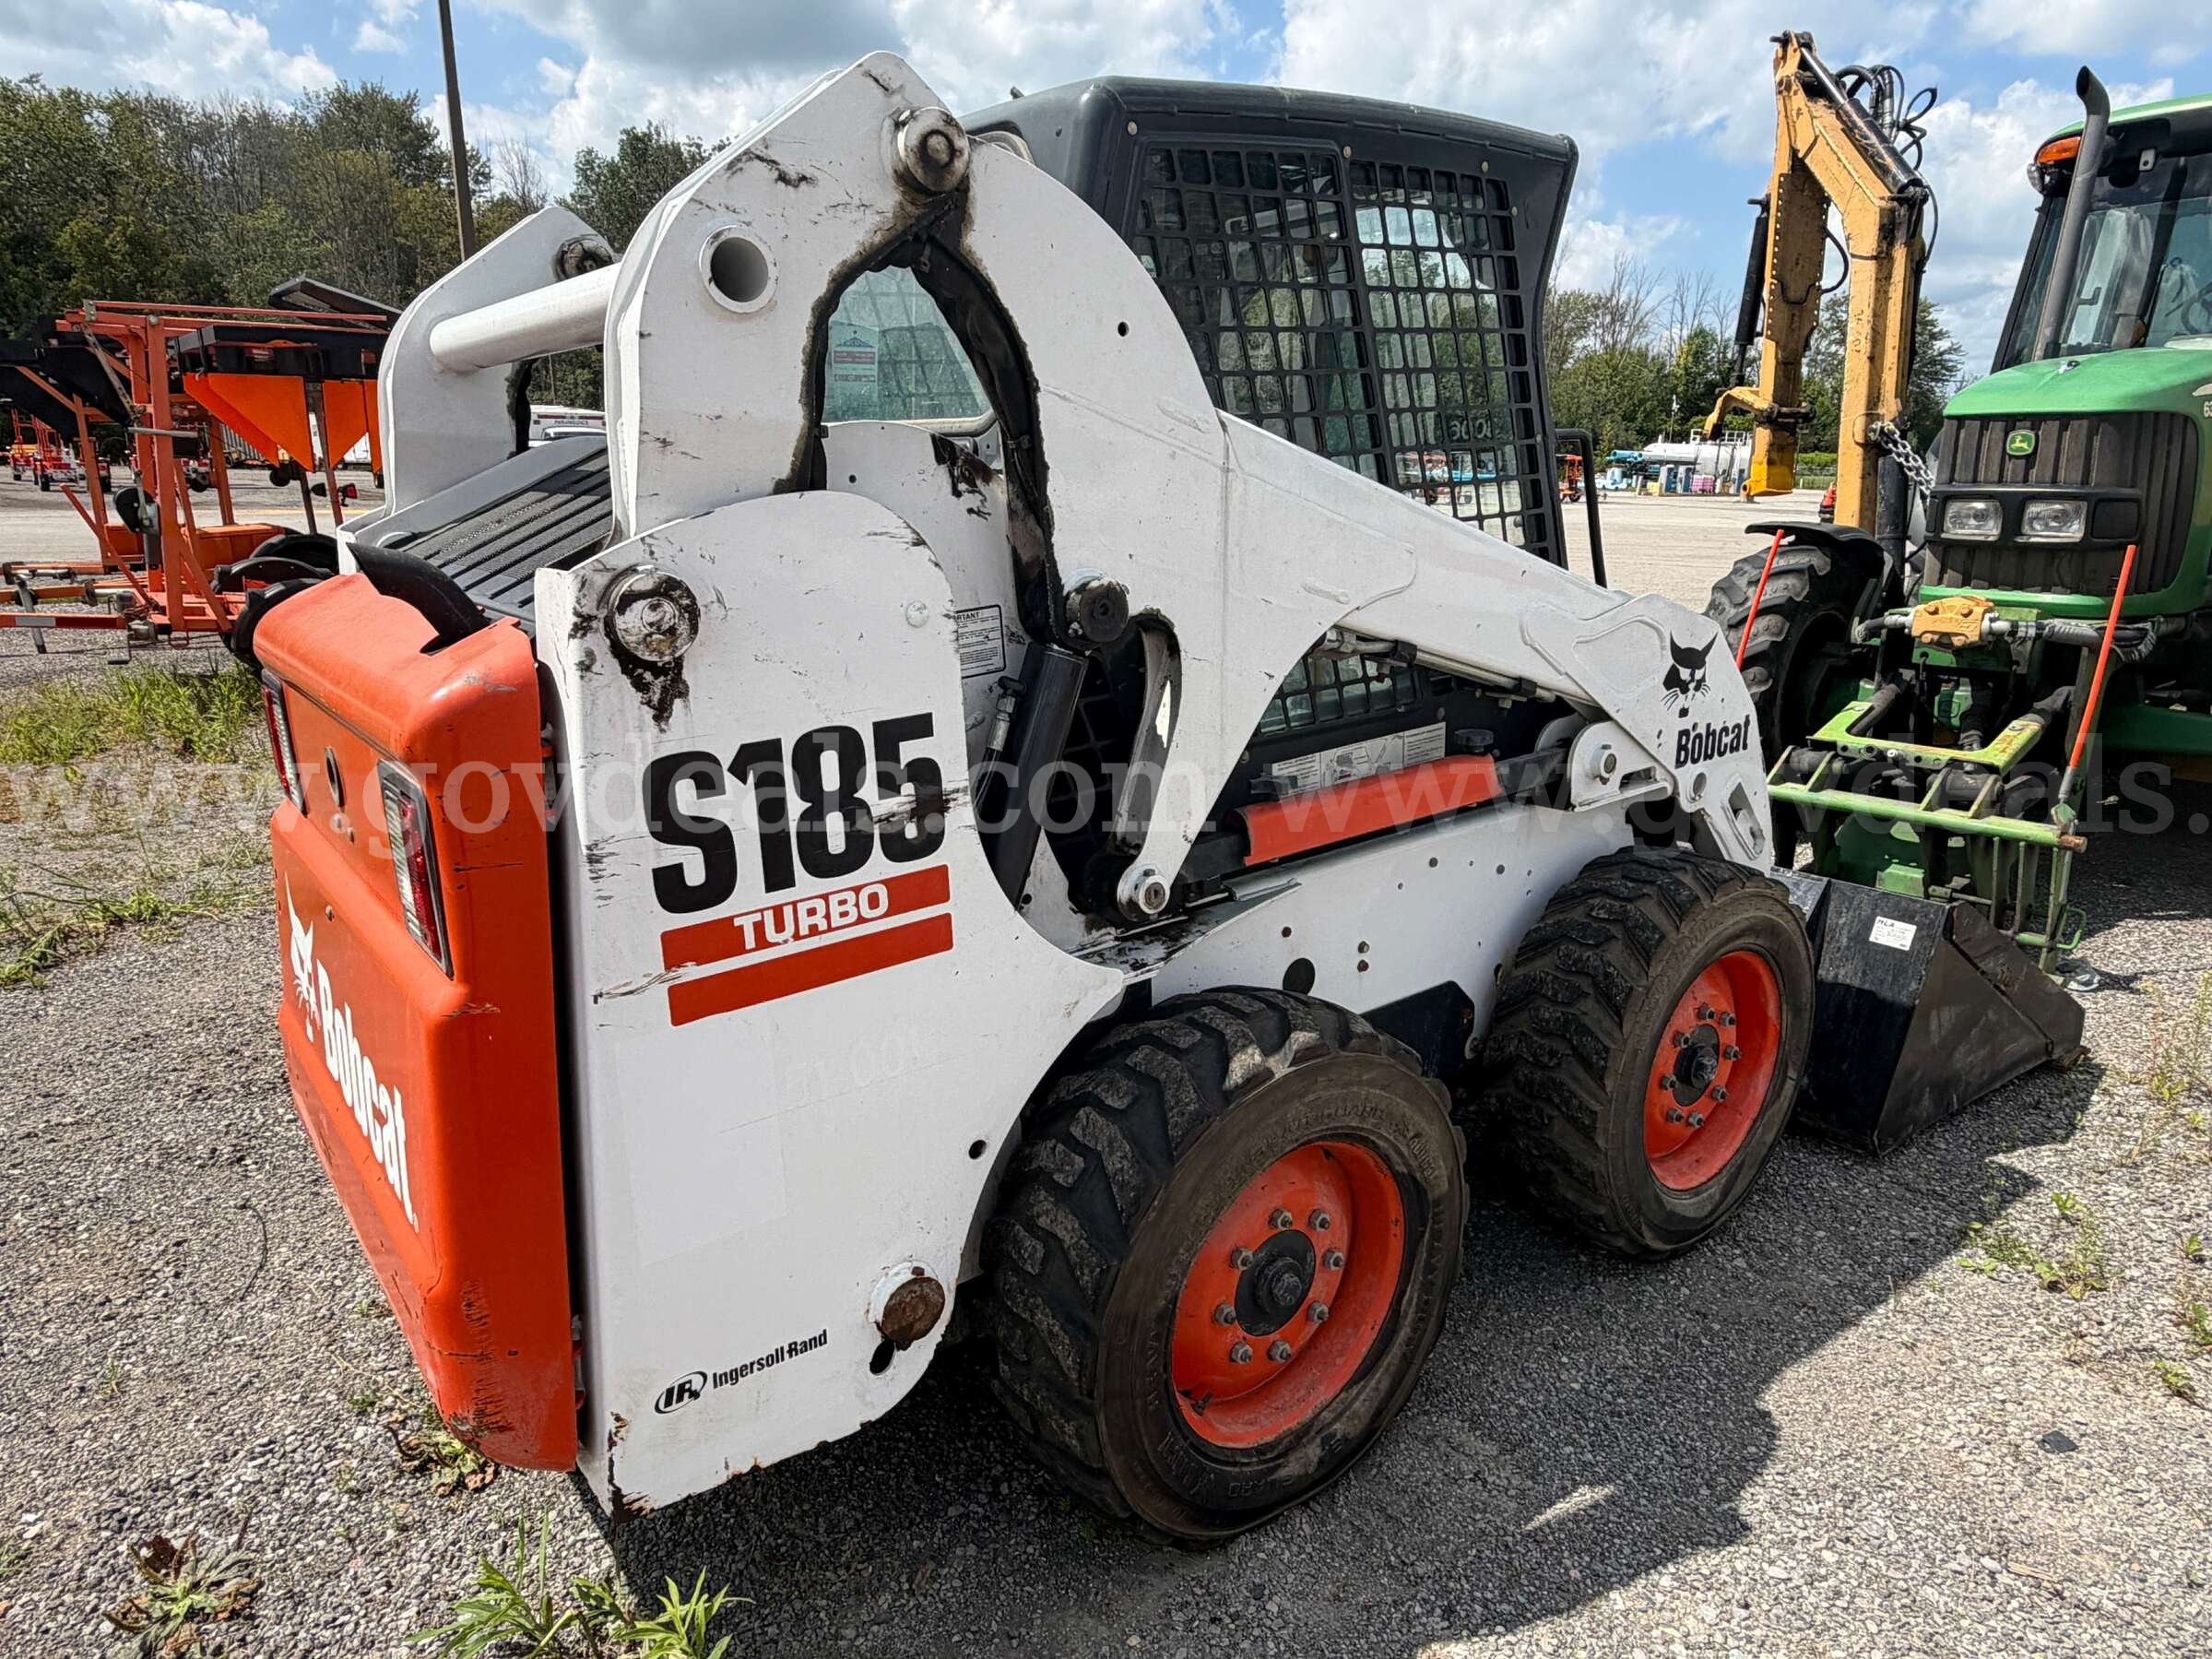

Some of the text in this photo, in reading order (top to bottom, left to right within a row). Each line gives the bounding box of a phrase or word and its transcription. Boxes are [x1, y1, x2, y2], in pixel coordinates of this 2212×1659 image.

[1674, 714, 1750, 769] Bobcat
[642, 712, 945, 914] S185
[734, 883, 888, 950] TURBO
[316, 958, 415, 1226] Bobcat
